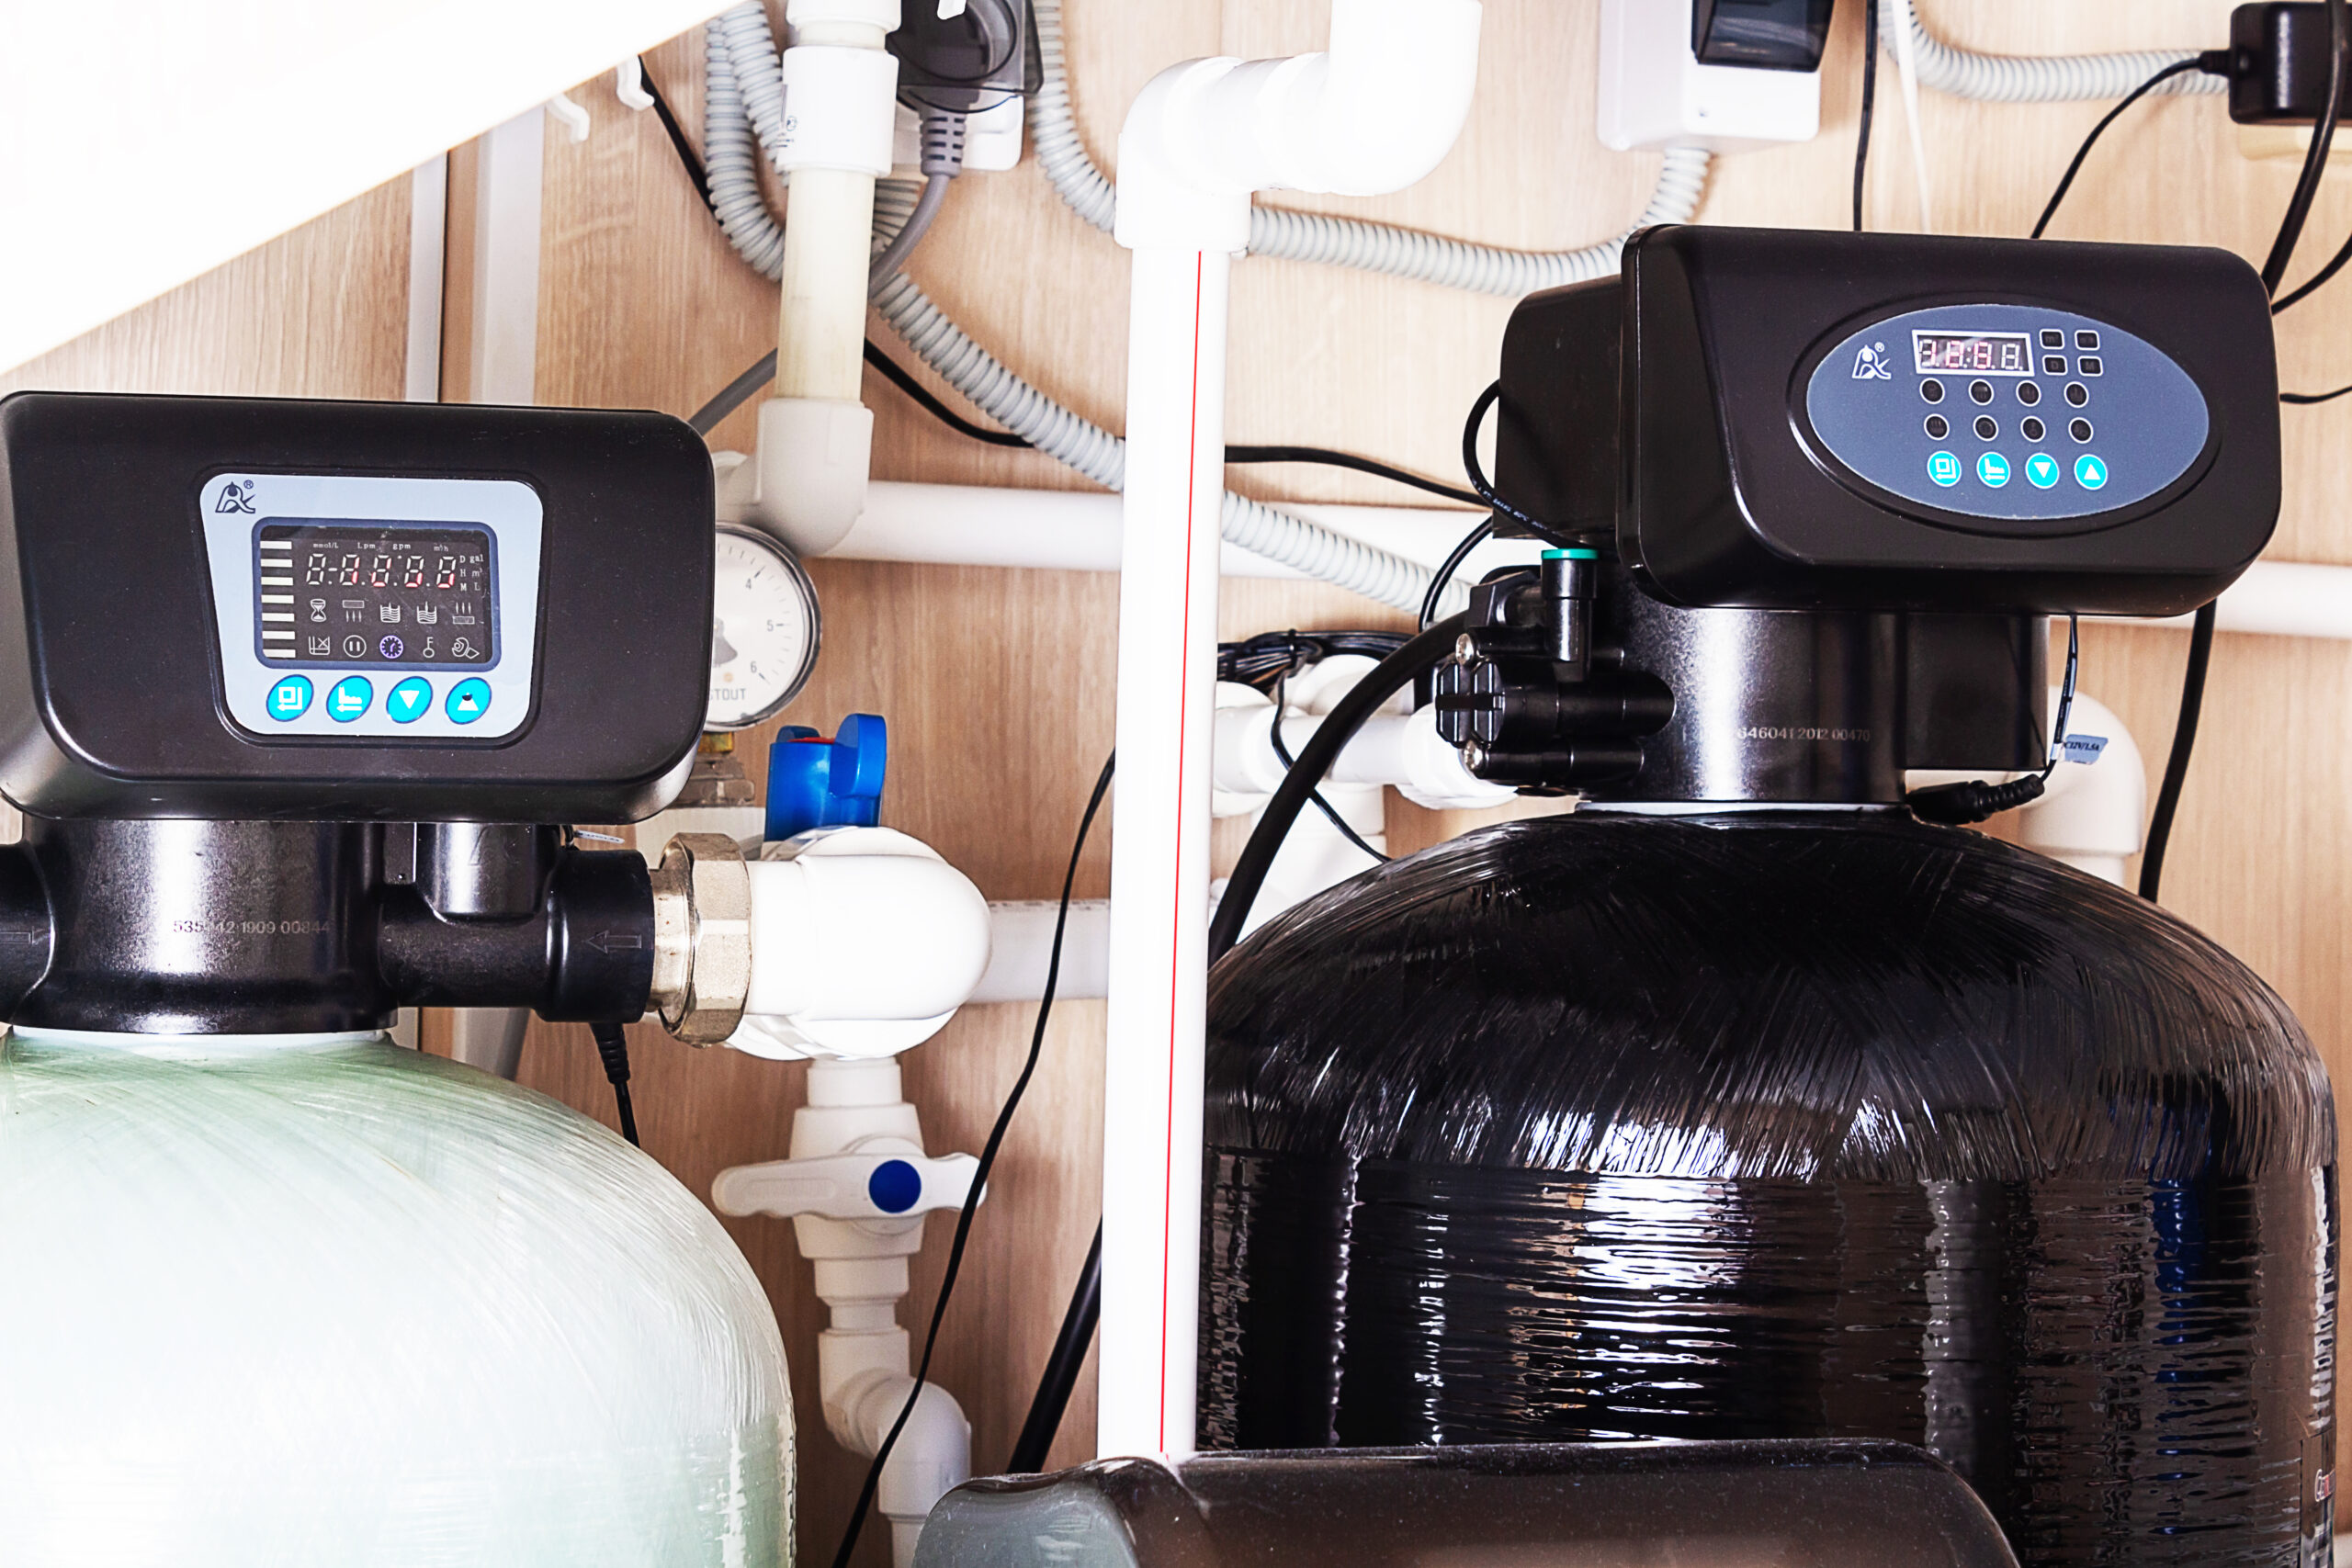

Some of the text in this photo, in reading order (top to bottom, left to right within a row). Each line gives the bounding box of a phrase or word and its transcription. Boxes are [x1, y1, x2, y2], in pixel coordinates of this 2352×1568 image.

[459, 553, 484, 564] D gal
[459, 569, 466, 577] H
[460, 581, 481, 592] M L
[745, 578, 752, 590] 4
[766, 619, 774, 632] 5
[750, 660, 757, 673] 6
[1797, 728, 1828, 740] 2012
[242, 921, 276, 934] 1909
[280, 920, 331, 934] 00844
